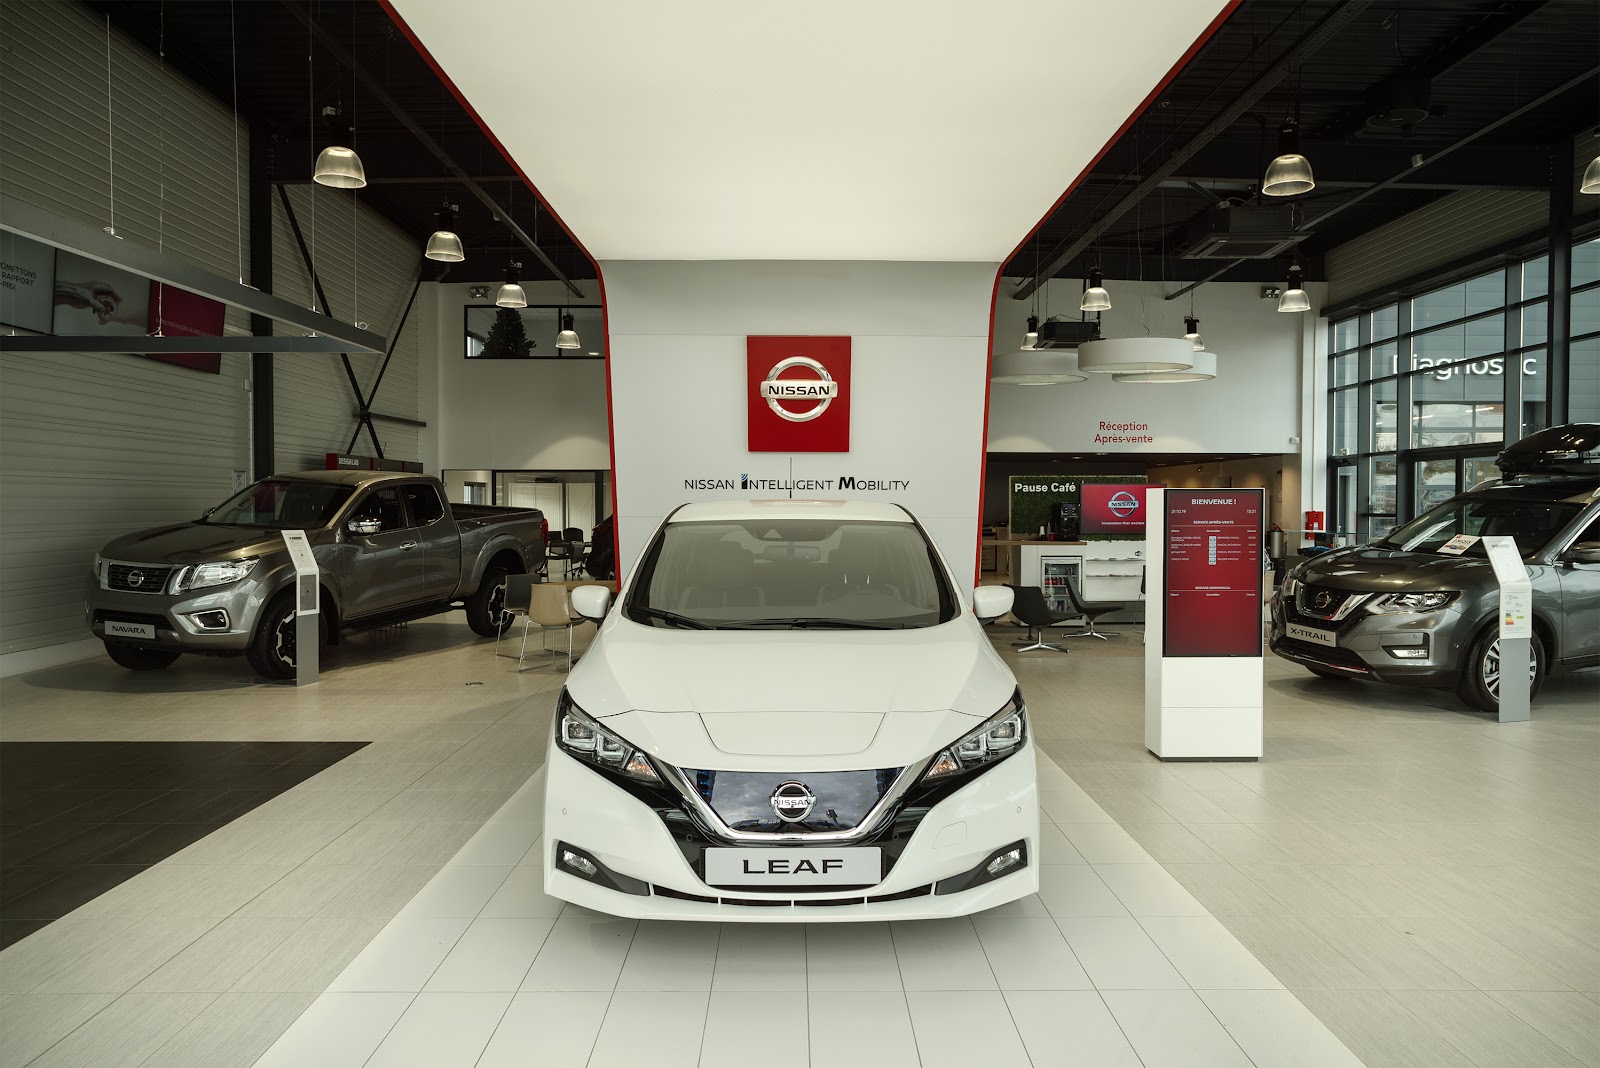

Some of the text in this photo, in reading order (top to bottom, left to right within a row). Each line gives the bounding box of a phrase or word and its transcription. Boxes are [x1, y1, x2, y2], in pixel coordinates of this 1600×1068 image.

[2, 272, 34, 287] RAPPORT
[768, 385, 830, 395] NISSAN
[1099, 421, 1148, 433] Réception
[1094, 434, 1153, 445] Après-vente
[684, 479, 735, 490] NISSAN
[1014, 482, 1076, 492] Pause Café
[112, 625, 146, 635] NAVARA
[1290, 627, 1331, 642] X-TRAIL
[743, 859, 844, 874] LEAF
